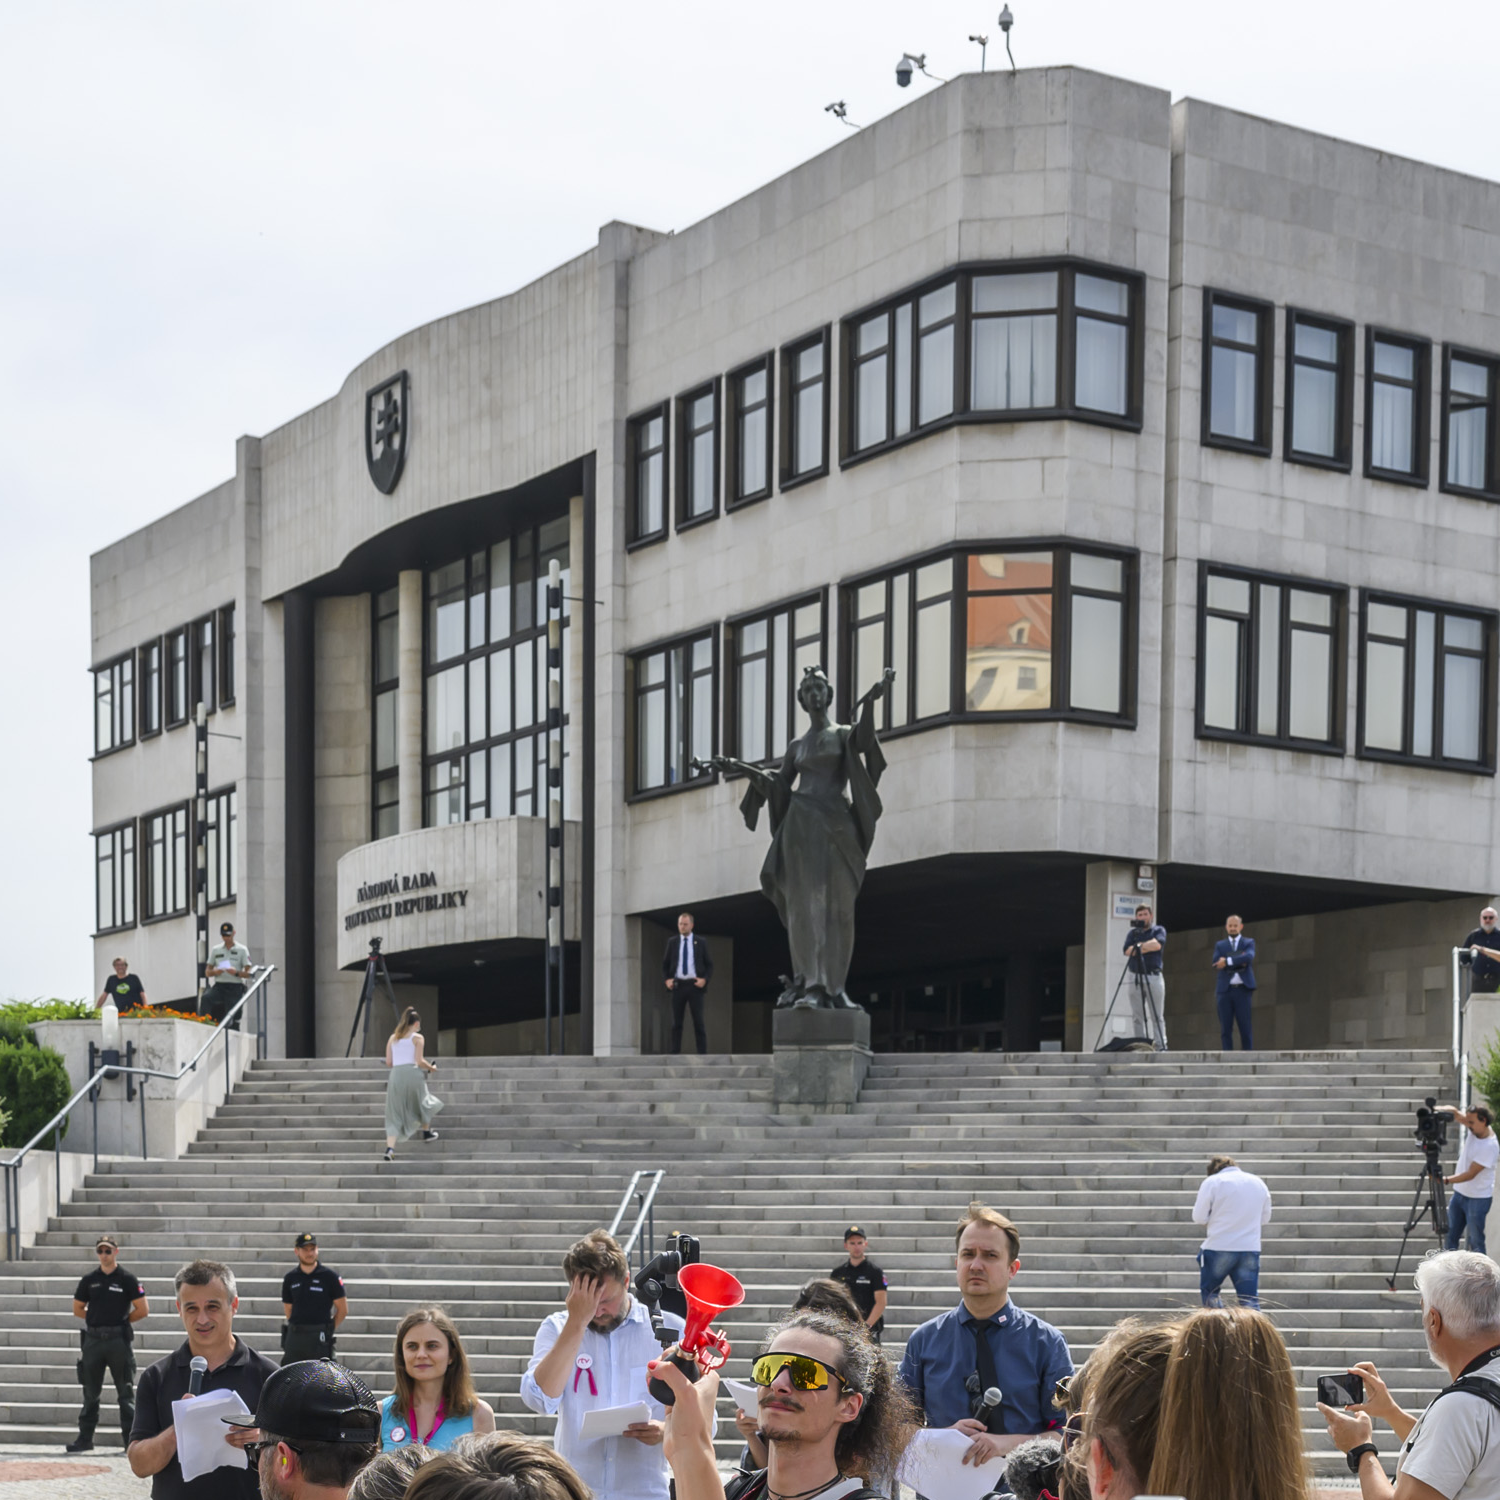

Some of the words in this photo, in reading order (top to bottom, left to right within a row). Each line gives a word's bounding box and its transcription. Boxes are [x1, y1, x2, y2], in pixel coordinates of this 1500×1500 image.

[357, 872, 400, 903] NÁRODNÁ
[402, 871, 437, 892] RADA
[394, 889, 469, 918] REPUBLIKY
